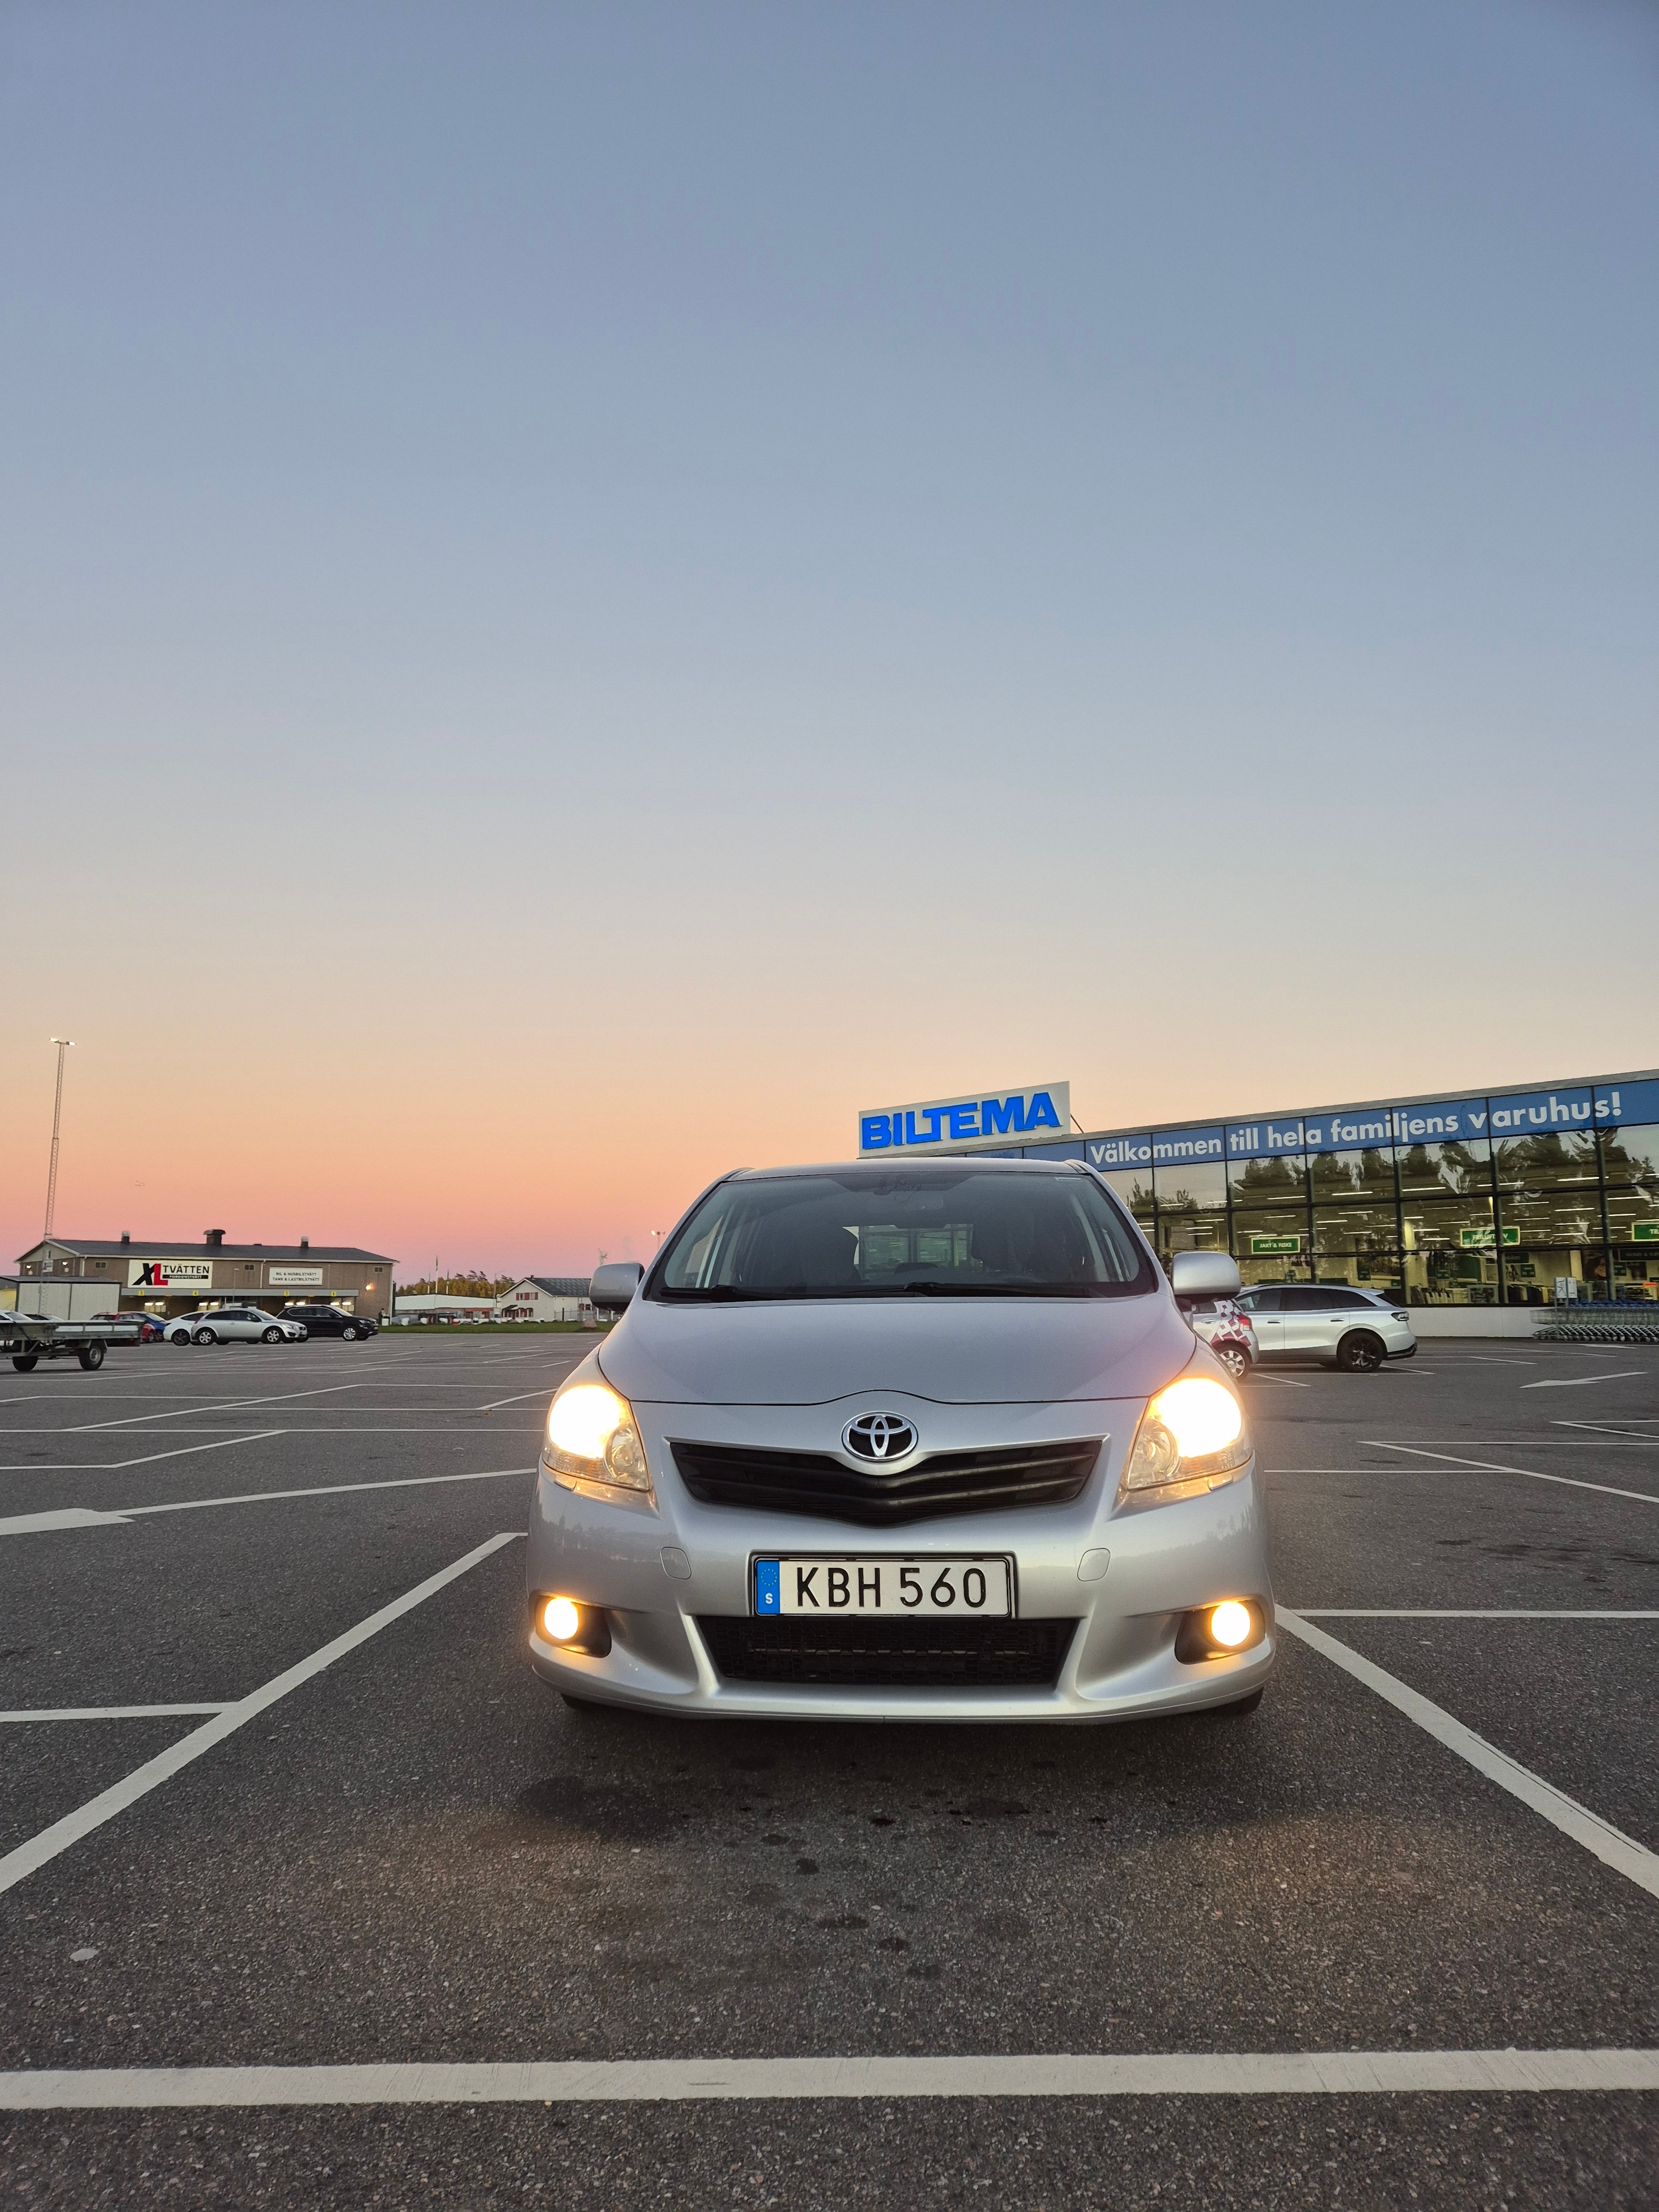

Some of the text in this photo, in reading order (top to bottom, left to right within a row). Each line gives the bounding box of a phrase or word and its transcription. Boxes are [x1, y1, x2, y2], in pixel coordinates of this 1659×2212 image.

[862, 1092, 1061, 1150] BILTEMA
[1090, 1092, 1622, 1164] Välkommen till hela familjens varuhus!
[132, 1263, 210, 1286] XL TVÄTTEN
[765, 1593, 773, 1604] S
[797, 1567, 986, 1608] KBH 560
